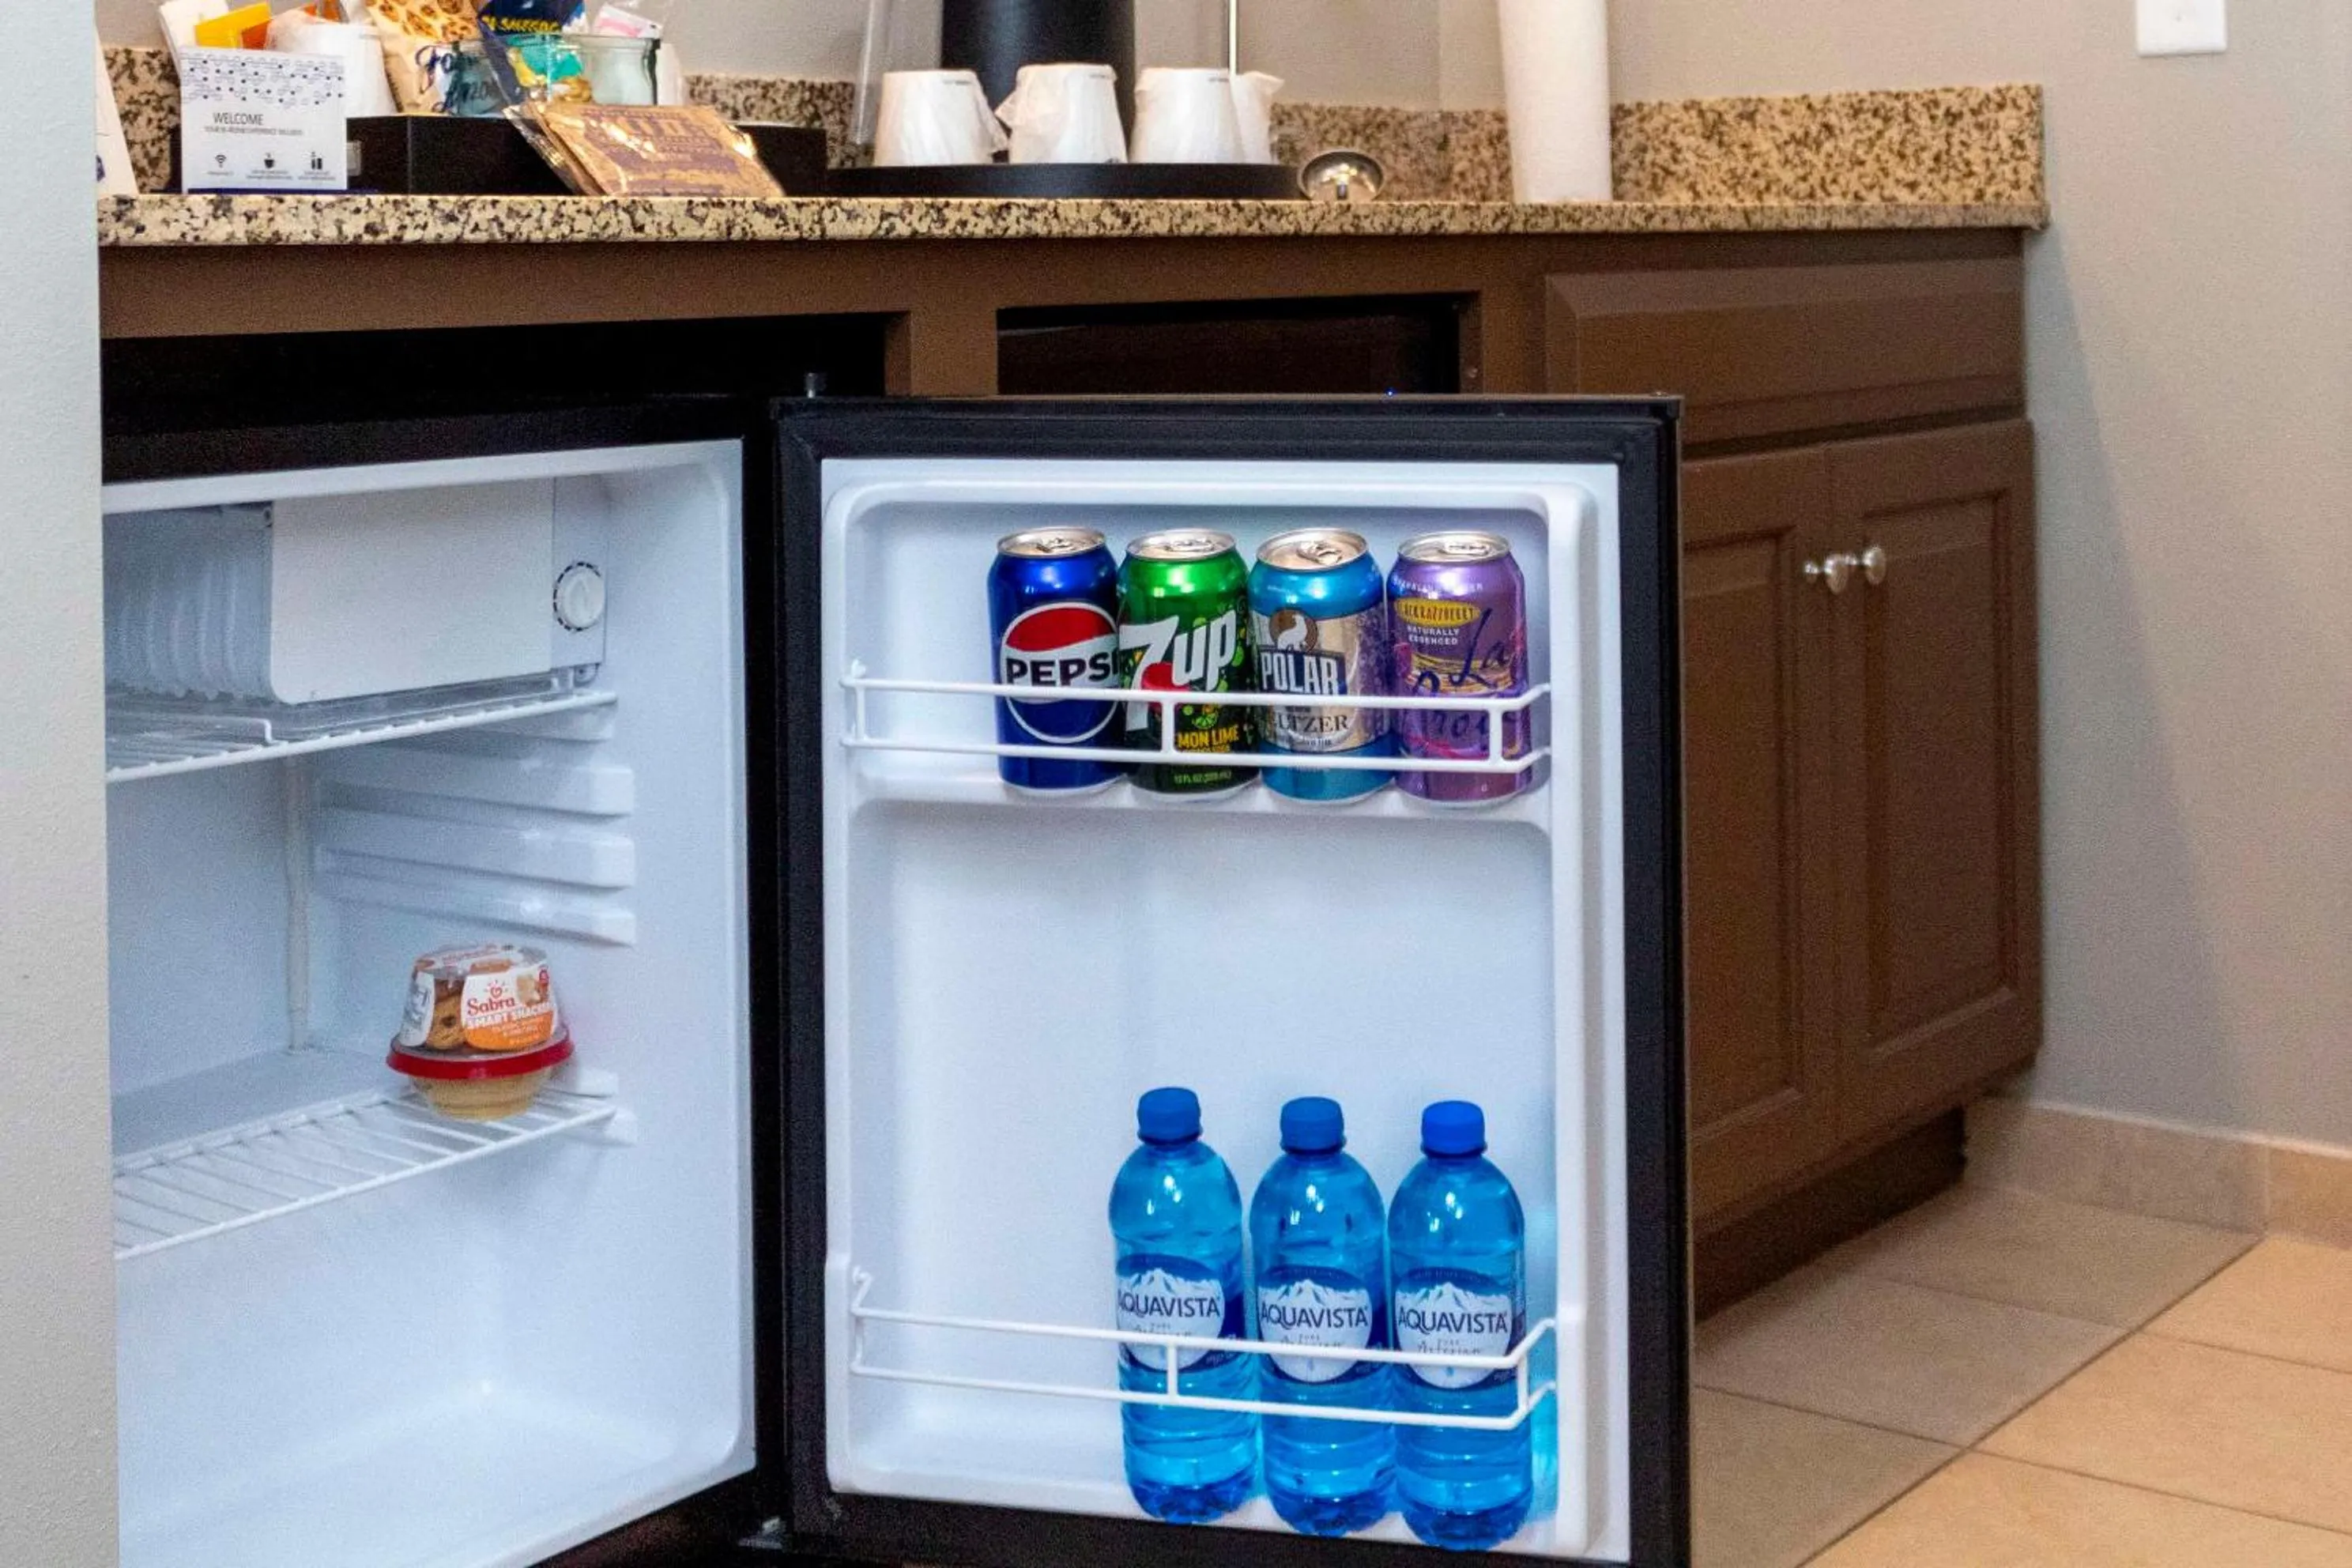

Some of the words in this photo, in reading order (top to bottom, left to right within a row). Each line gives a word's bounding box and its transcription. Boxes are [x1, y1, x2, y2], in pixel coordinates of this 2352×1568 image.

[213, 111, 264, 125] WELCOME
[1407, 624, 1461, 635] NATURALLY
[1408, 635, 1458, 646] ESSENCED
[1261, 652, 1339, 695] POLAR
[1211, 725, 1239, 745] LIME
[467, 997, 514, 1016] Sabra
[1261, 1302, 1369, 1330] AQUAVISTA
[1398, 1305, 1508, 1335] AQUAVISTA
